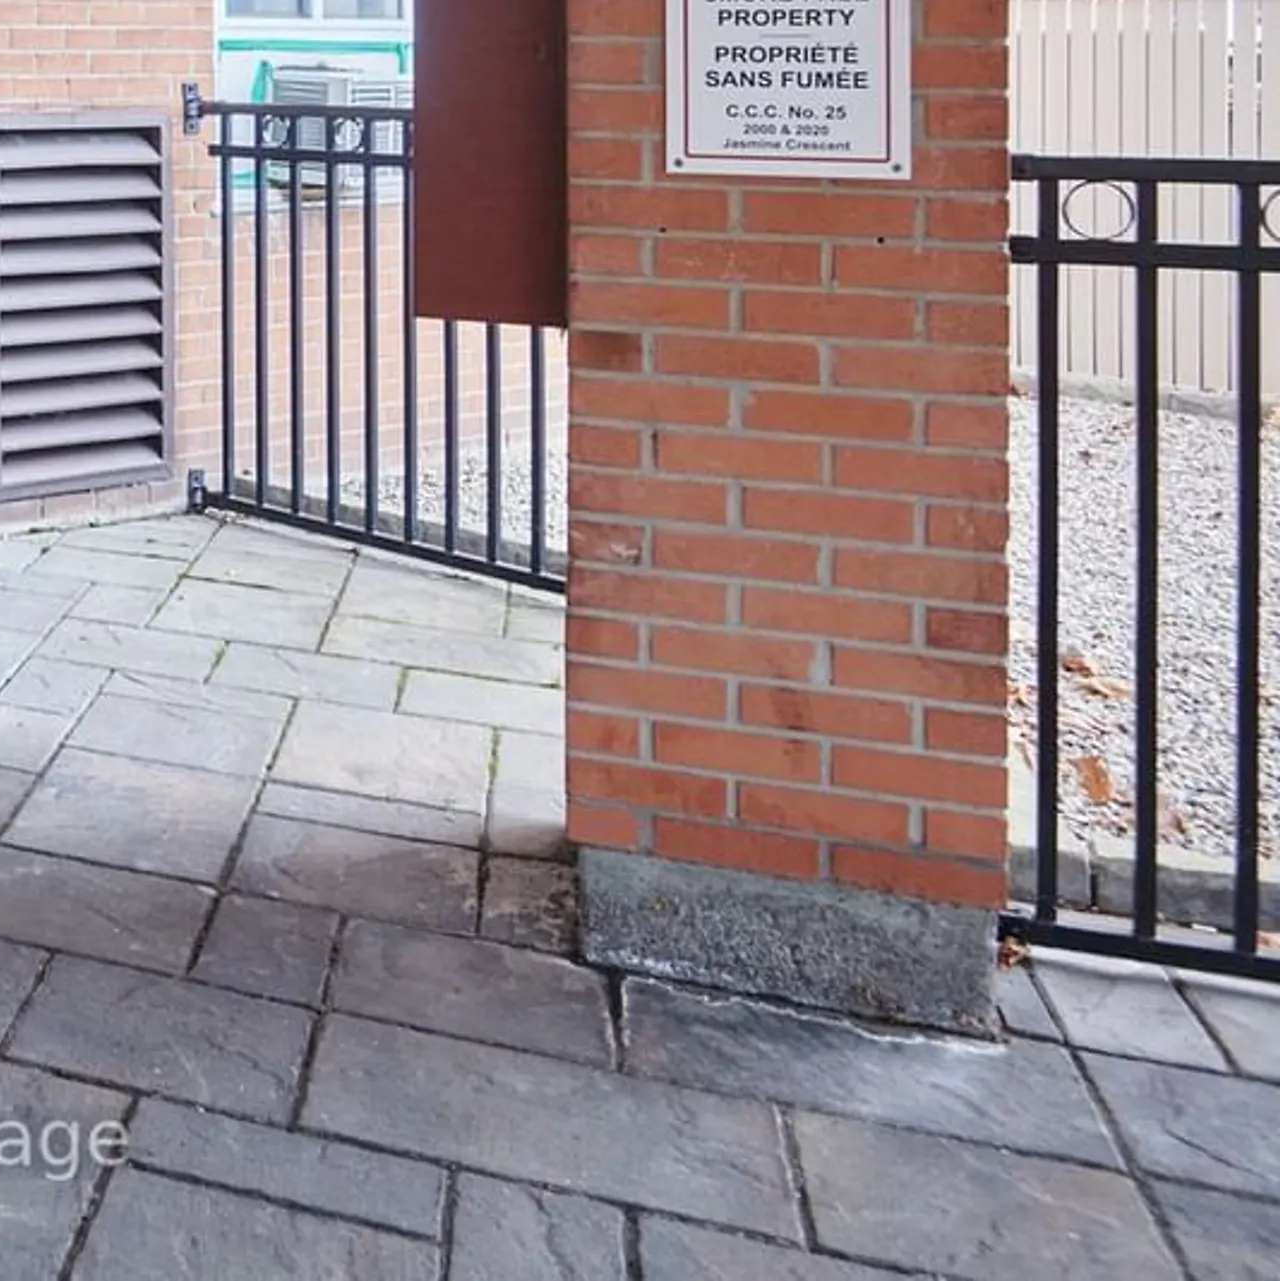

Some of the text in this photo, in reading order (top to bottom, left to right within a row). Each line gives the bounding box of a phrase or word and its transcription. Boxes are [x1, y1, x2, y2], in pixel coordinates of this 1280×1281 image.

[717, 8, 856, 27] PROPERTY
[714, 42, 859, 65] PROPRIÉTÉ
[704, 66, 870, 90] SANS FUMÉE
[724, 103, 848, 121] C.C.C. No. 25
[742, 123, 778, 136] 2000
[779, 124, 792, 137] &
[723, 138, 852, 152] Jasmine Crescent
